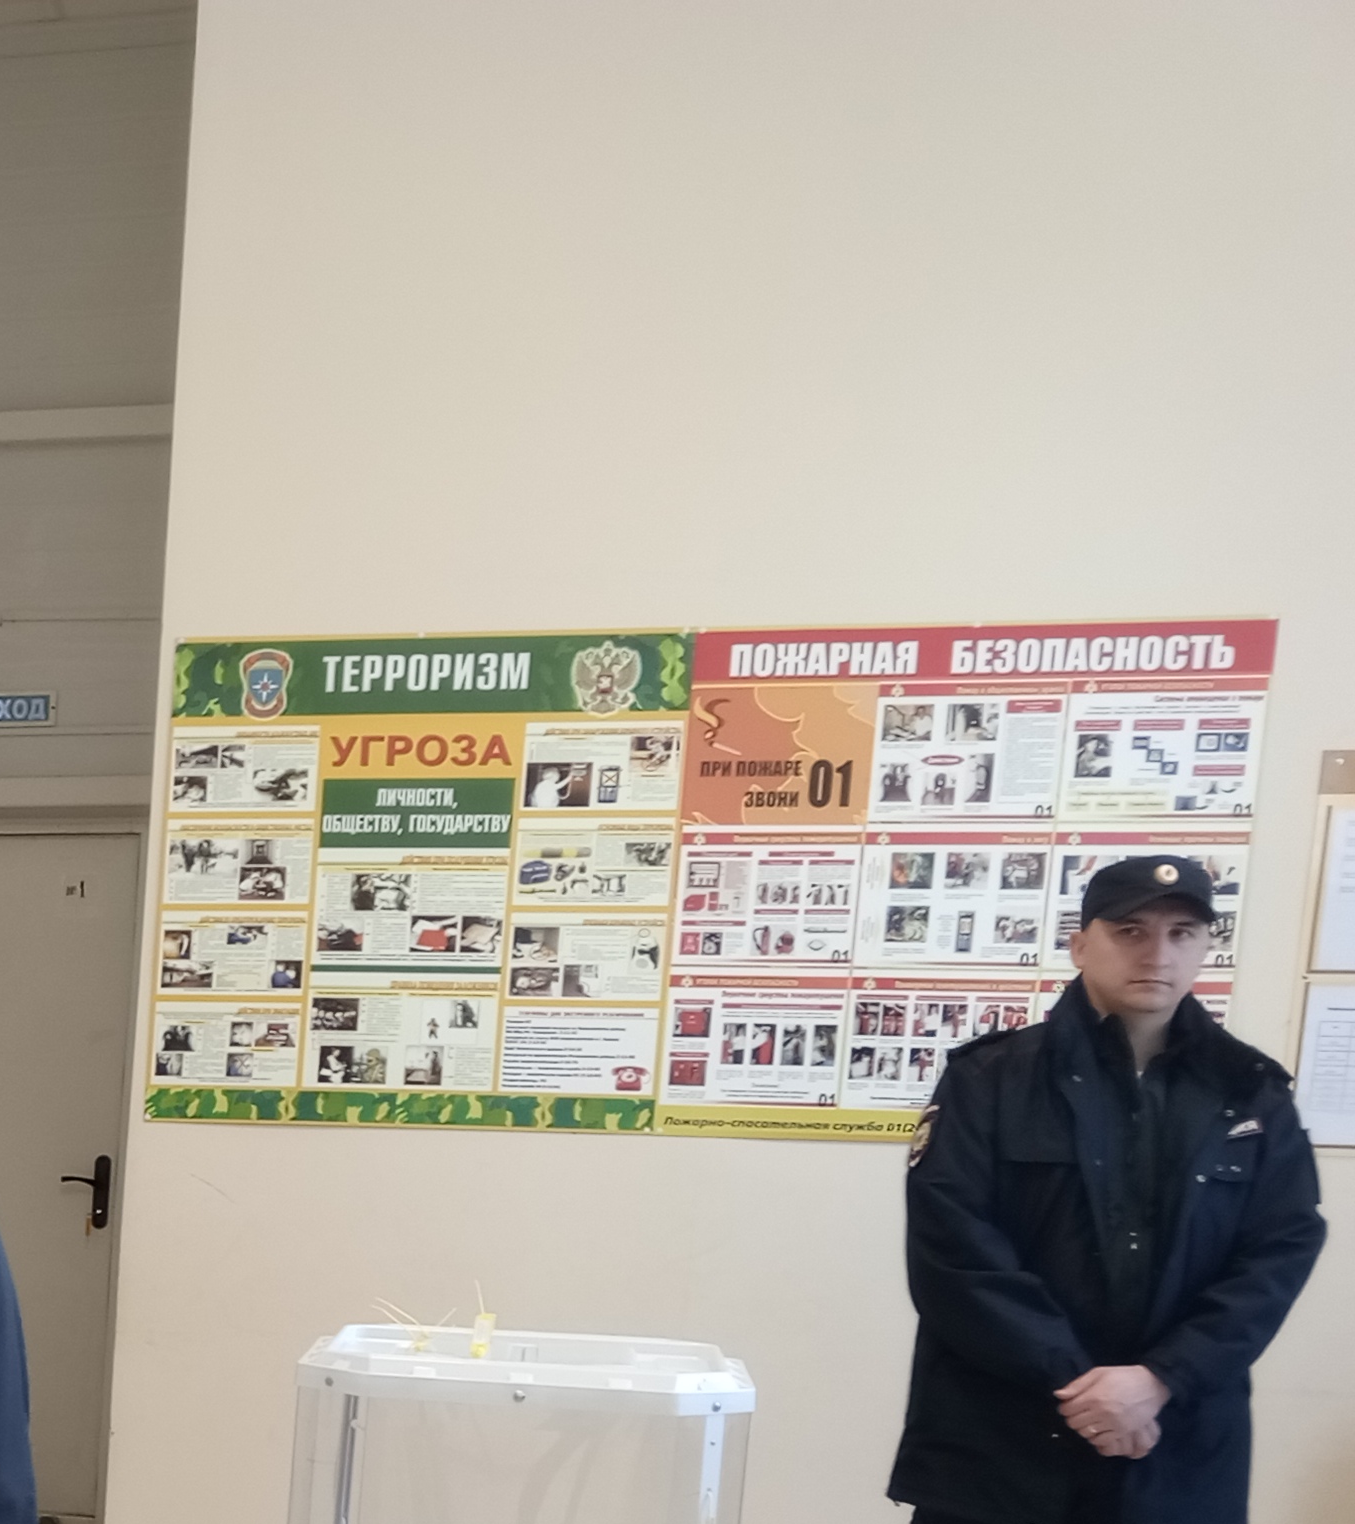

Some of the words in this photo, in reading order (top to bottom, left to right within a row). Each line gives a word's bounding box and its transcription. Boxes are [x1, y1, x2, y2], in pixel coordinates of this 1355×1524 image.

[729, 640, 919, 677] ПОЖАРНАЯ
[951, 635, 1236, 673] БЕЗОПАСНОСТЬ
[322, 652, 531, 693] ТЕРРОРИЗМ
[330, 734, 512, 767] УГРОЗА
[700, 762, 732, 778] ПРИ
[734, 761, 803, 778] ПОЖАРЕ
[807, 758, 854, 808] 01
[376, 787, 459, 810] ЛИЧНОСТИ,
[744, 790, 800, 808] ЗВОНИ
[322, 814, 404, 836] ОБЩЕСТВУ,
[408, 814, 511, 835] ГОСУДАРСТВУ
[663, 1116, 831, 1133] Пожарно-спасательная
[833, 1121, 884, 1134] служба
